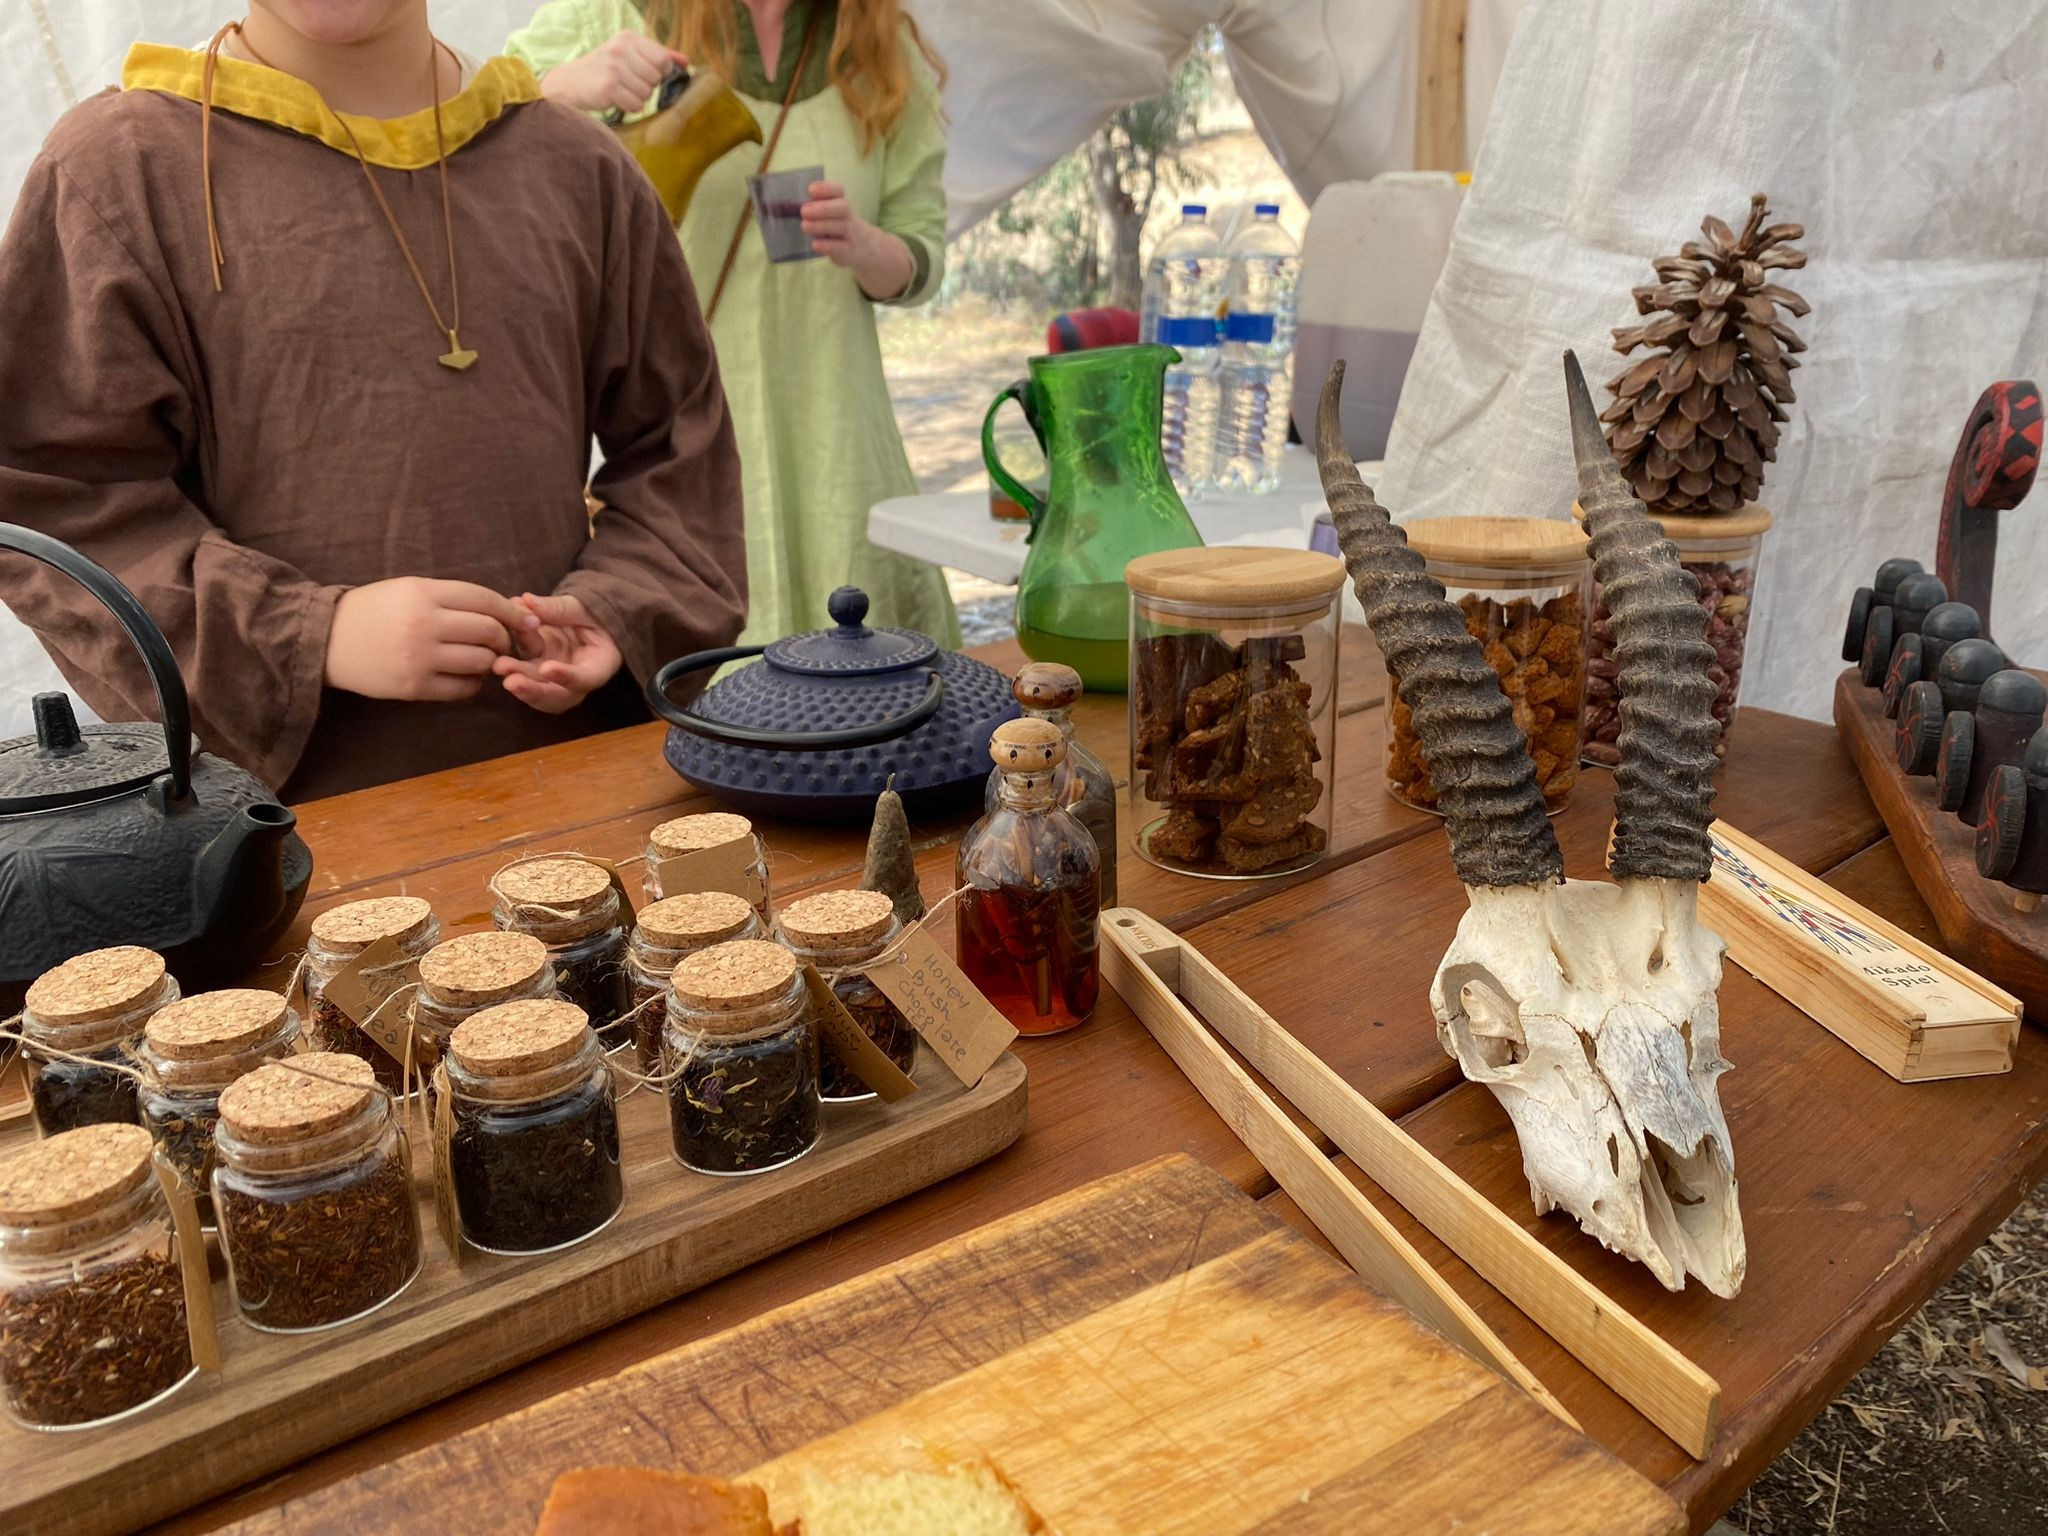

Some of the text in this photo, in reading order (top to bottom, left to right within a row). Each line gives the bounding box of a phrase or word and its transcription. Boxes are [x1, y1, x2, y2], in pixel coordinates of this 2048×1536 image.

[912, 970, 951, 1022] Bush
[923, 953, 970, 1009] Honey
[1881, 975, 1940, 988] Spiel
